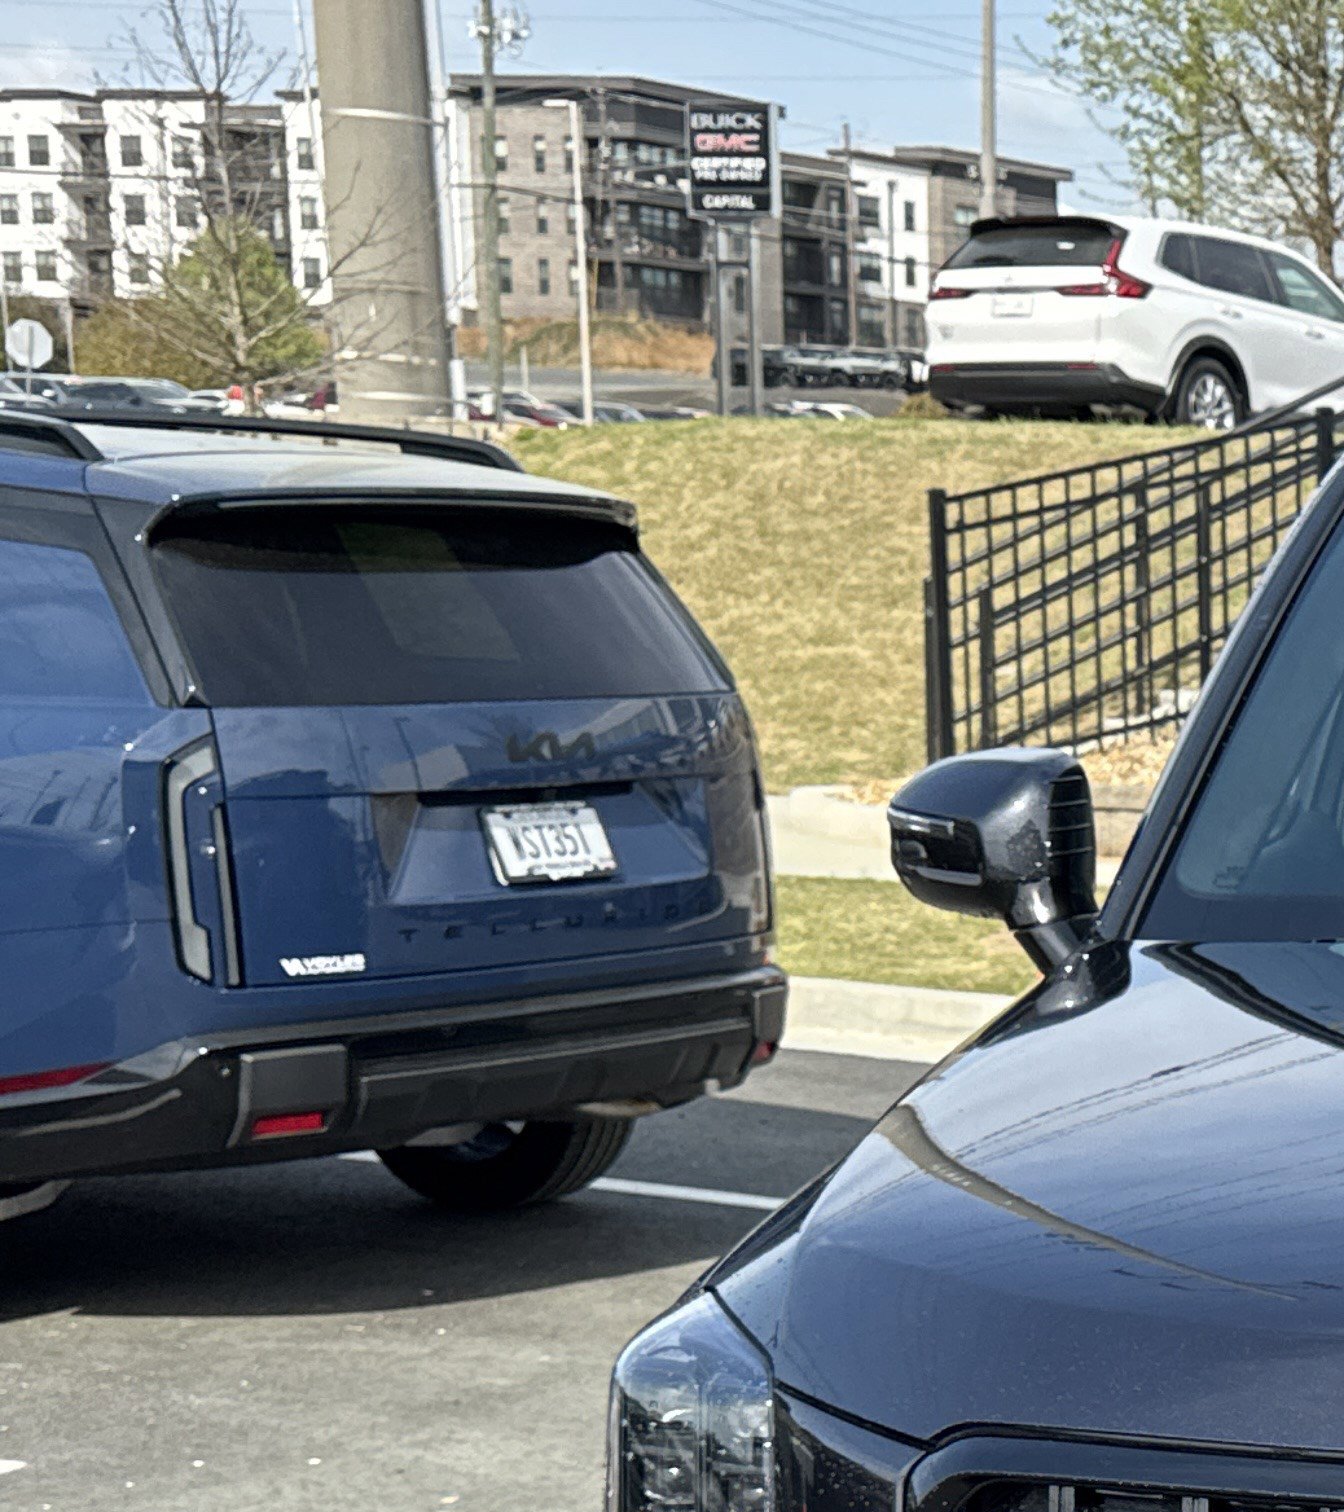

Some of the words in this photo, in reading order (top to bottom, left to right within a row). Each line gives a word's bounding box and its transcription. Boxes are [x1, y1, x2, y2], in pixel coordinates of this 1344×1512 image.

[690, 112, 762, 131] BUICK
[694, 133, 761, 152] GMC
[702, 194, 756, 209] CAPITAL
